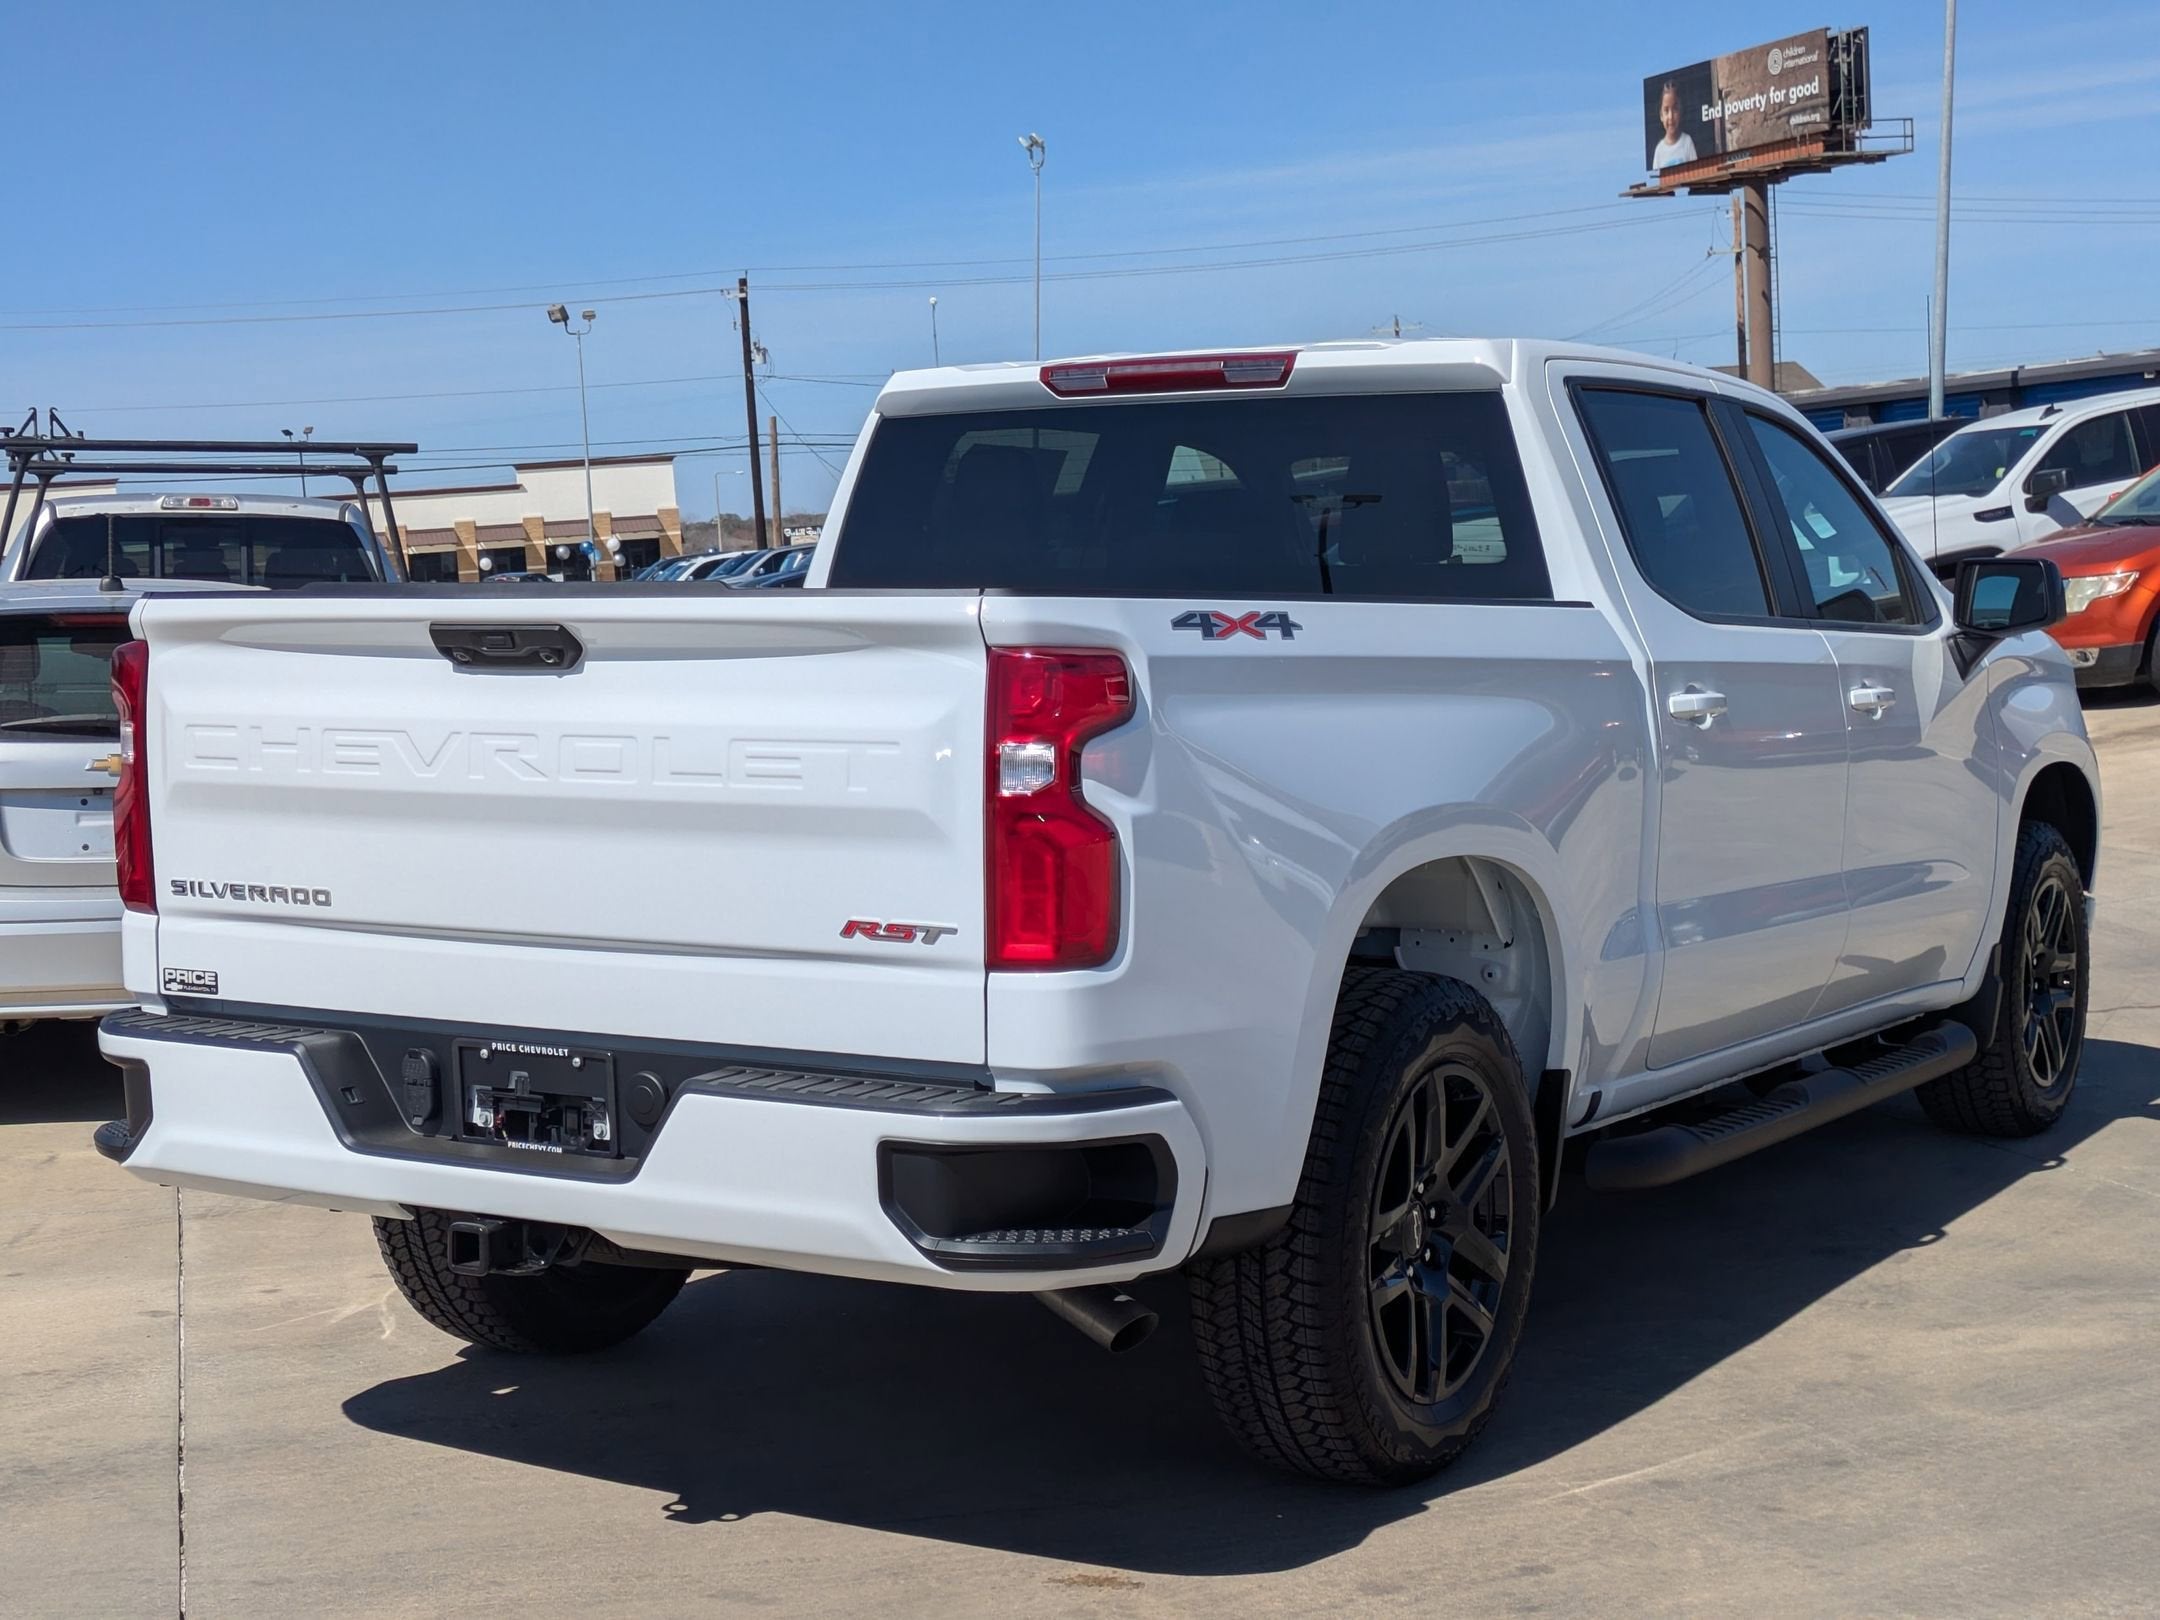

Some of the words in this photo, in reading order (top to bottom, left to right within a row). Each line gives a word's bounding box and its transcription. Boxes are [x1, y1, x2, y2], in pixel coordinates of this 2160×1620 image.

[1782, 45, 1806, 58] children
[1783, 50, 1819, 69] international
[1701, 99, 1722, 122] End
[1725, 93, 1767, 120] poverty
[1769, 86, 1787, 105] for
[1789, 75, 1820, 105] good
[183, 724, 901, 792] CHEVROLET
[170, 879, 332, 907] SILVERADO
[839, 919, 958, 945] RST
[164, 968, 216, 986] PRICE
[491, 1042, 517, 1053] PRICE
[518, 1044, 569, 1057] CHEVROLET
[507, 1140, 563, 1153] PRICECHEVY.COM
